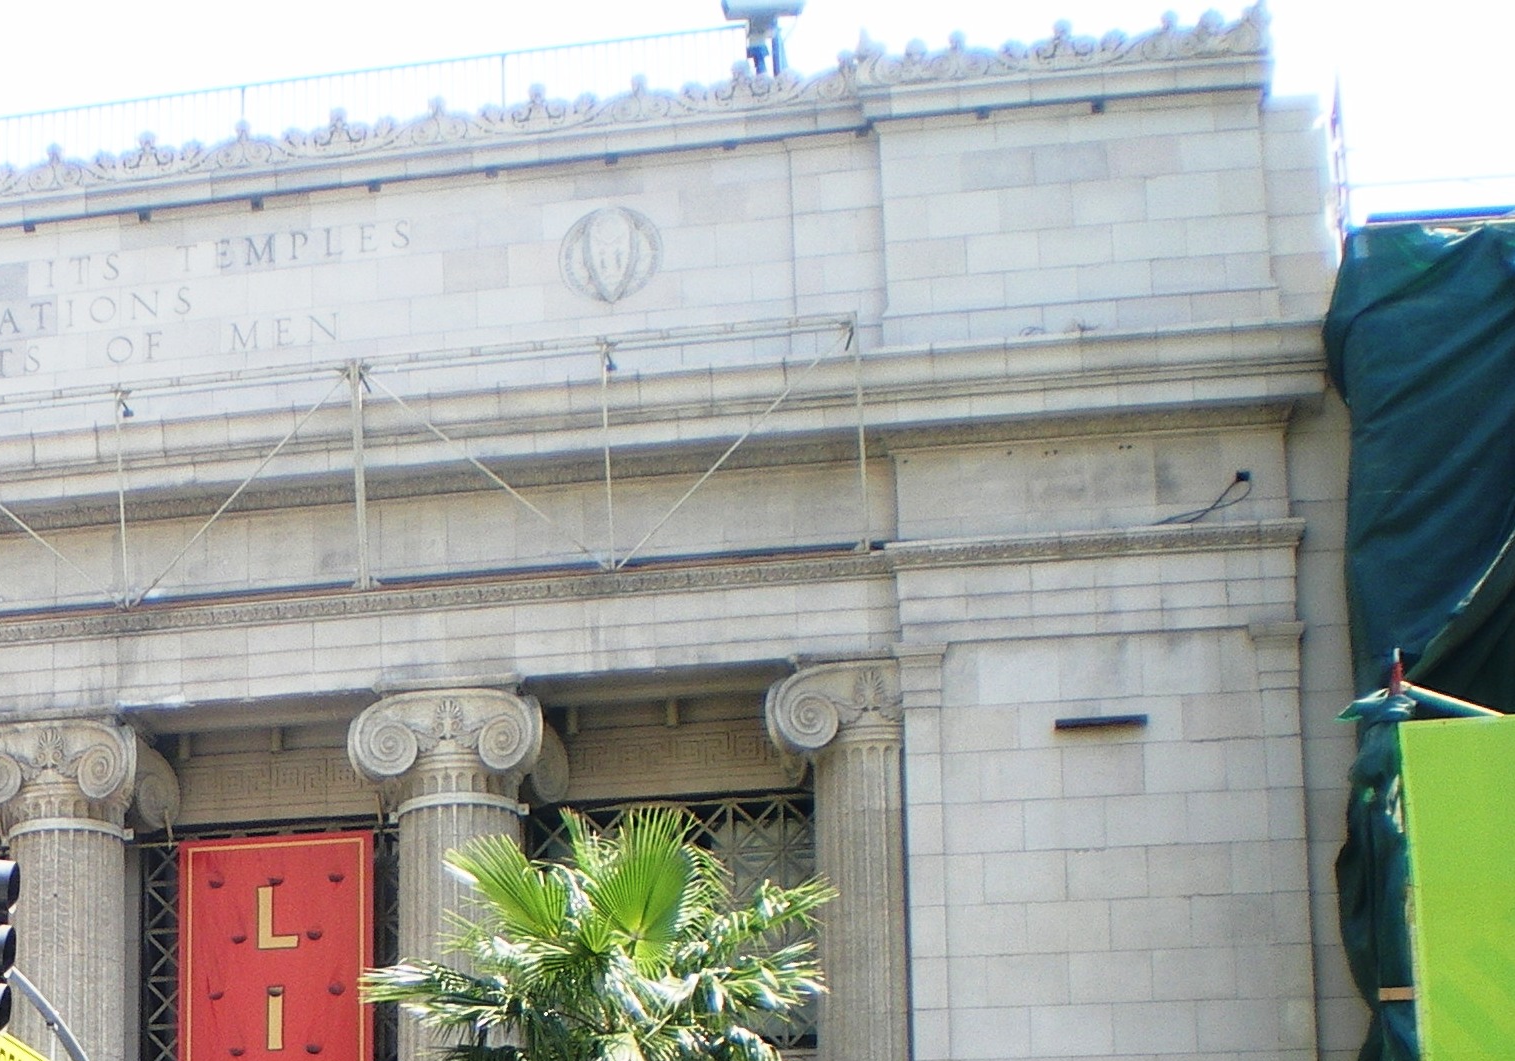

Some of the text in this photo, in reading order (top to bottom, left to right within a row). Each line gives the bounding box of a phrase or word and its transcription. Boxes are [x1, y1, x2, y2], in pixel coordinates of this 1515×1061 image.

[44, 253, 120, 289] ITS
[176, 219, 412, 273] TEMPLES
[106, 331, 163, 364] OF
[230, 312, 340, 351] MEN
